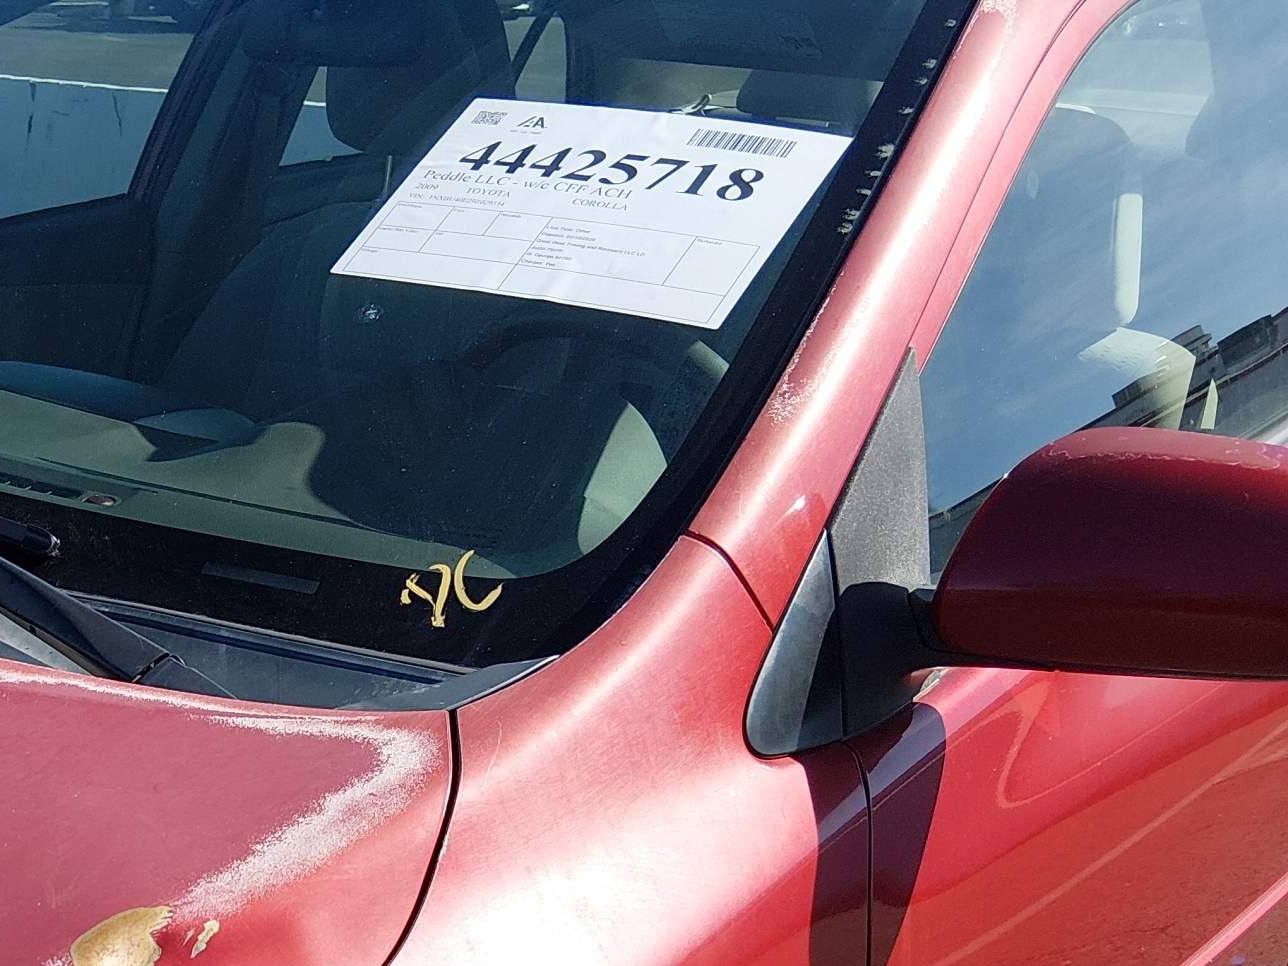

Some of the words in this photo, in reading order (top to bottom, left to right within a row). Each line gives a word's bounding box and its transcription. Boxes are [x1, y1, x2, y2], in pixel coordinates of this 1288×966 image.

[424, 169, 471, 183] Peddle
[475, 174, 511, 186] LLC
[524, 181, 550, 190] w/c
[590, 185, 633, 199] ACH
[459, 140, 764, 201] 44425718
[415, 182, 439, 190] 2009
[466, 187, 510, 198] TOYOTA
[572, 198, 628, 211] COROLLA
